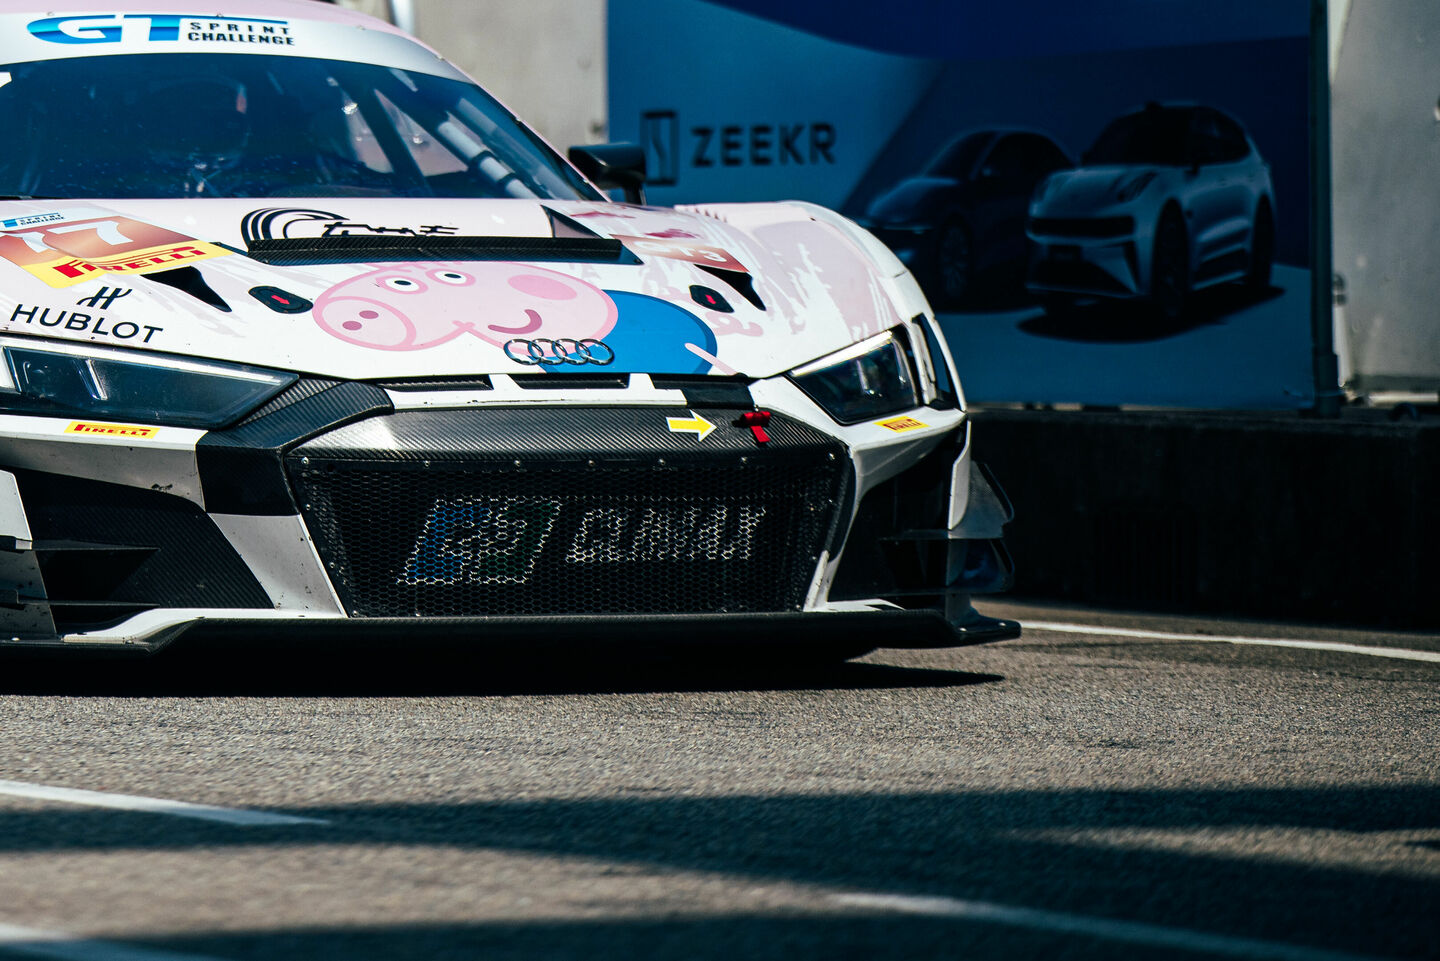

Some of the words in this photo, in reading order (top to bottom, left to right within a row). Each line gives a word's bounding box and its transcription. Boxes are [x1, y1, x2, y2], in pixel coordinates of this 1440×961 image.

[26, 14, 200, 45] GT
[186, 32, 296, 46] CHALLENGE
[190, 21, 290, 36] SPRINT
[690, 122, 837, 168] ZEEKR
[52, 245, 208, 279] PIRELLI
[10, 303, 164, 344] HUBLOT
[73, 423, 152, 436] PIRELLI
[882, 418, 923, 431] PIRELLI
